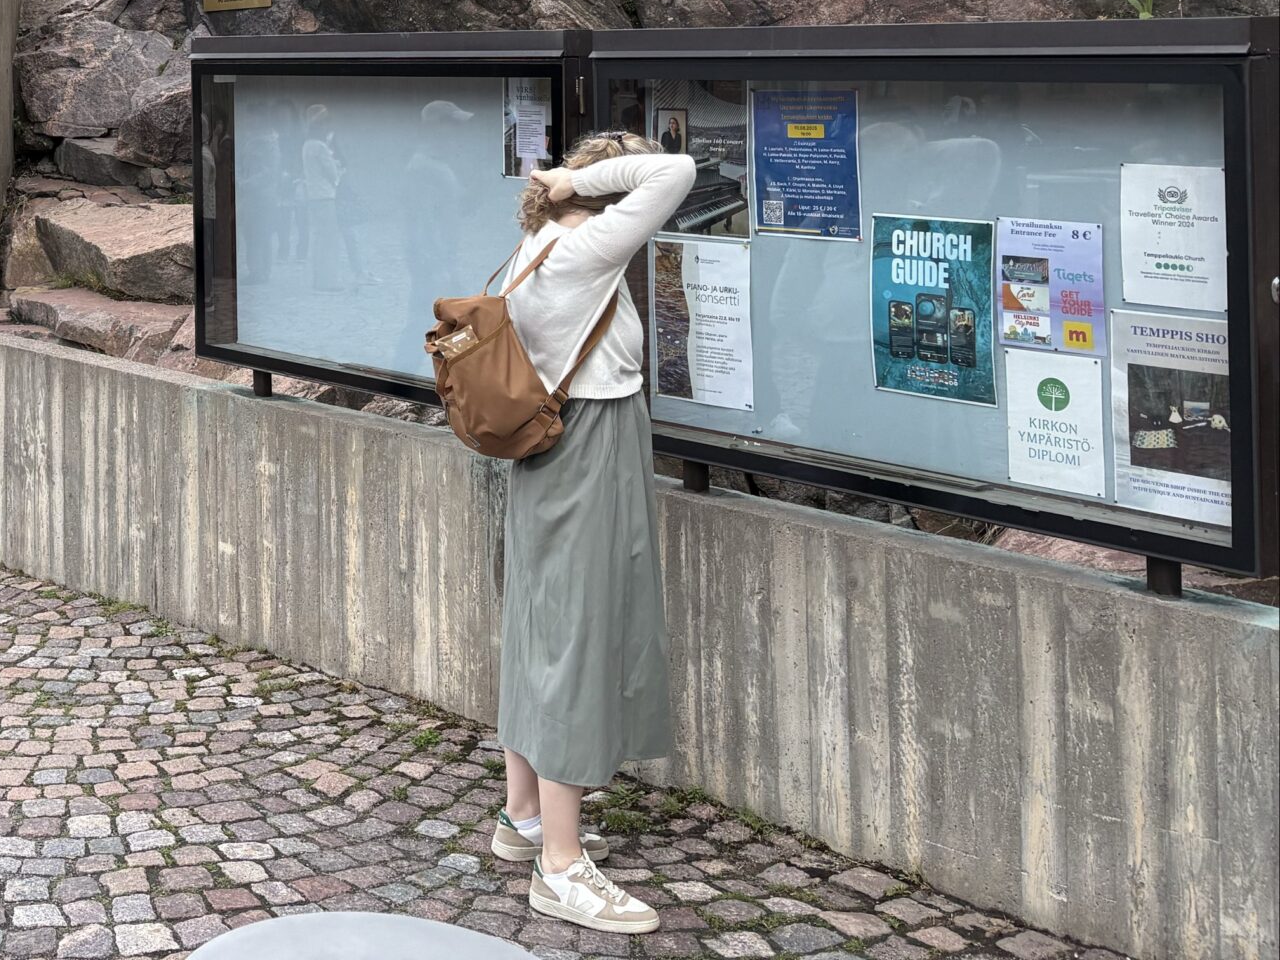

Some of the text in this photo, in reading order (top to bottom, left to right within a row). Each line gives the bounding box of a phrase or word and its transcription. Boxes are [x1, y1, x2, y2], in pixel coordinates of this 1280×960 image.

[1153, 204, 1192, 213] Tripadvisor
[1151, 219, 1176, 227] Winner
[1165, 212, 1190, 221] Choice
[1192, 214, 1219, 223] Awards
[1010, 220, 1062, 230] Vierailumaksu
[1010, 228, 1057, 238] Entrance Fee
[1071, 229, 1092, 240] 8 €
[891, 229, 972, 261] CHURCH
[1184, 254, 1205, 262] Church
[891, 257, 950, 289] GUIDE
[1053, 268, 1095, 284] Tiqets
[686, 283, 740, 295] PIANO- JA URKU-
[1016, 288, 1036, 300] Card
[1061, 289, 1080, 299] GET
[695, 290, 740, 307] konsertti
[1061, 299, 1091, 308] YOUR
[1061, 306, 1094, 317] GUIDE
[1013, 314, 1039, 322] HELSINKI
[1068, 329, 1087, 342] m
[1130, 325, 1193, 341] TEMPPIS
[1197, 347, 1220, 355] KIRKON
[1029, 417, 1078, 435] KIRKON
[1018, 430, 1095, 453] YMPÄRISTÖ-
[1028, 447, 1080, 466] DIPLOMI
[1140, 478, 1170, 489] SOUVENIR
[1170, 484, 1186, 492] SHOP
[1186, 487, 1208, 495] INSIDE
[1148, 488, 1170, 496] UNIQUE
[1184, 495, 1225, 506] SUSTAINABLE
